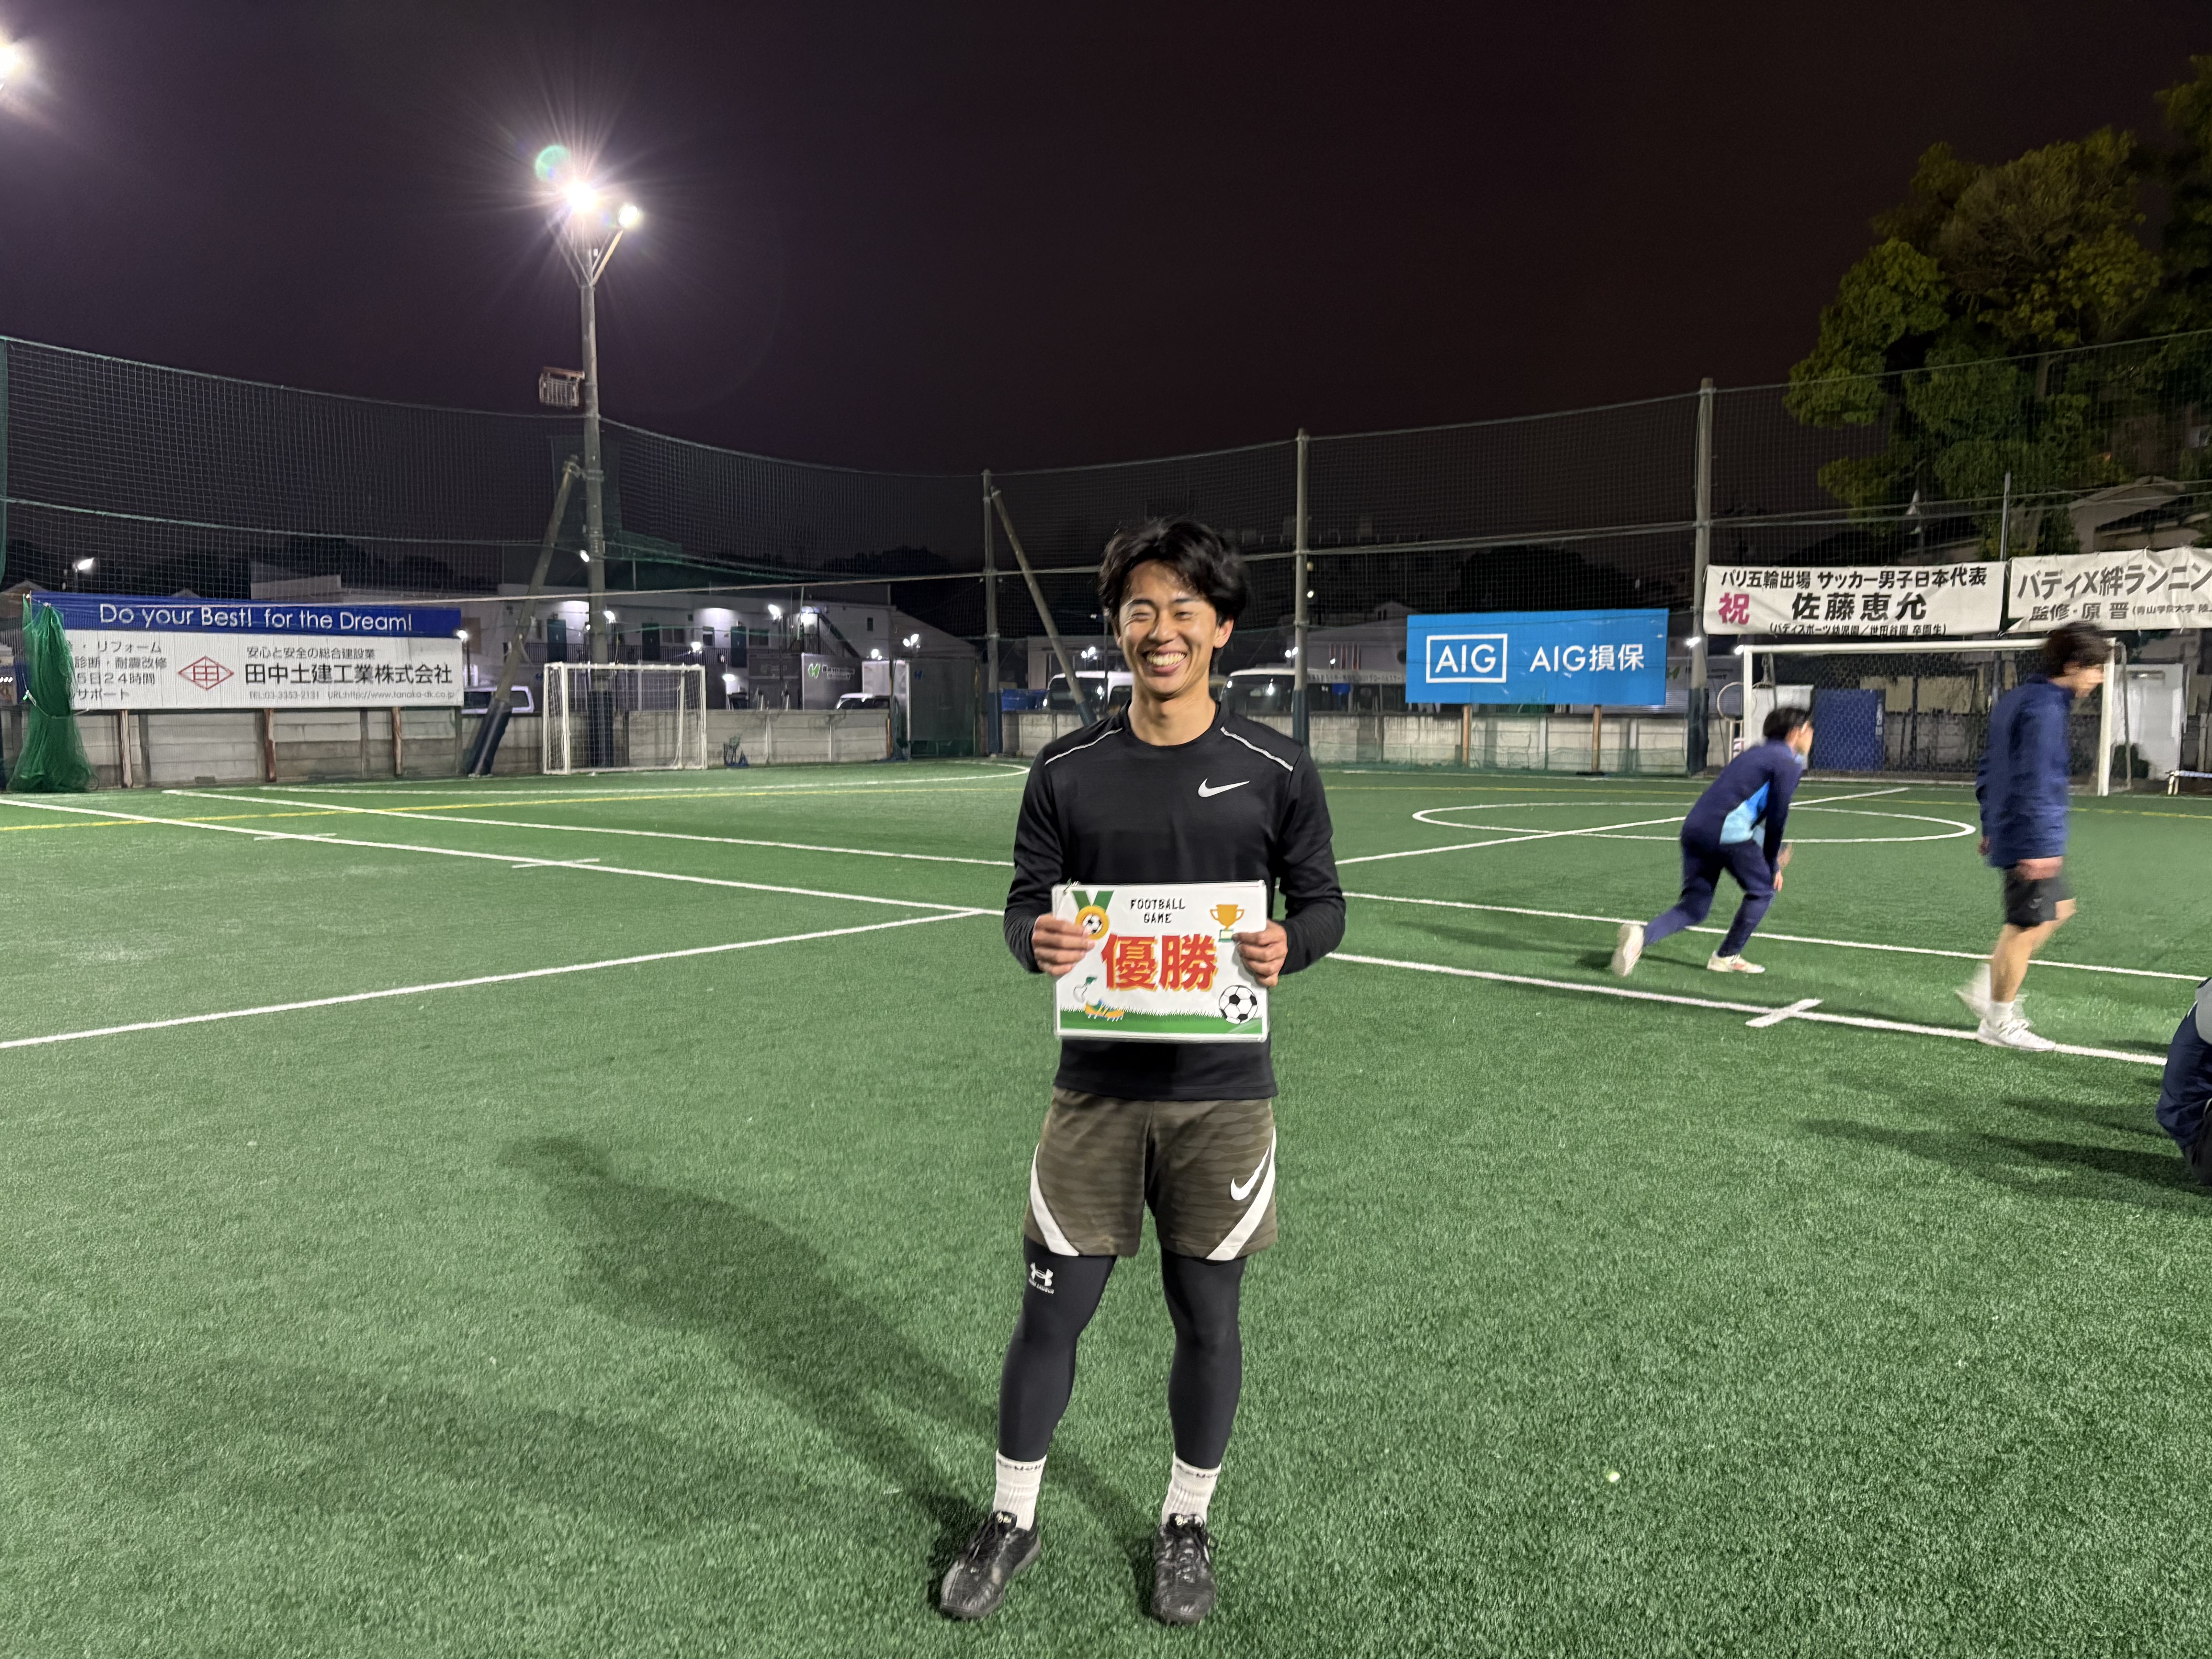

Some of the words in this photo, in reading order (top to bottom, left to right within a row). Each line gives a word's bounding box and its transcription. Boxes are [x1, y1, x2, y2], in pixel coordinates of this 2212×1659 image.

[1721, 568, 1811, 589] パリ五輪出場
[1817, 567, 1987, 589] サッカー男子日本代表
[100, 603, 134, 624] Do
[142, 608, 194, 629] your
[201, 606, 252, 627] Best!
[264, 608, 293, 628] for
[299, 610, 333, 629] the
[340, 611, 412, 632] Dream!
[1718, 592, 1750, 625] 祝
[1791, 592, 1927, 620] 佐藤恵允
[1435, 644, 1496, 673] AIG
[1529, 644, 1644, 672] AIG損保
[245, 663, 453, 685] 田中土建工業株式会社
[1130, 898, 1186, 910] FOOTBALL
[1144, 912, 1172, 924] GAME
[1101, 933, 1218, 992] 優勝
